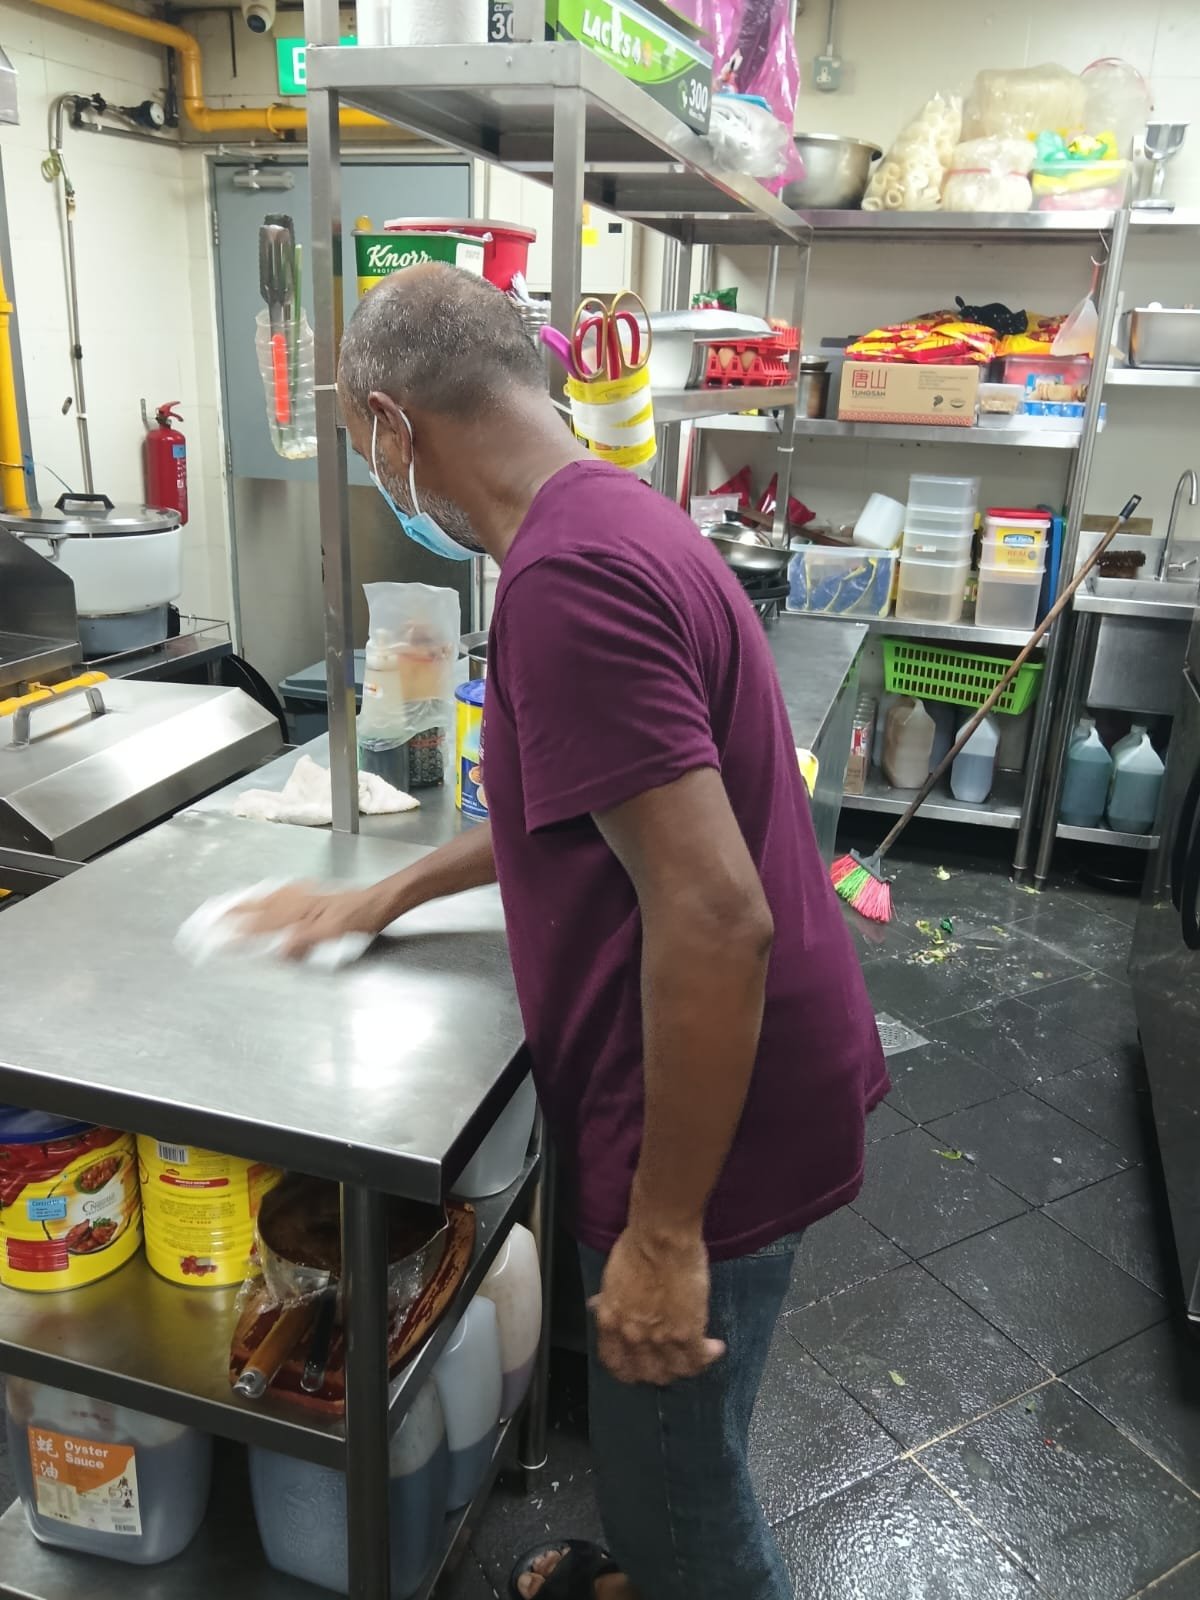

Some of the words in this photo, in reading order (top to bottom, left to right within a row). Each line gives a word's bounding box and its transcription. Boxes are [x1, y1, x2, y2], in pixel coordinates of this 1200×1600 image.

[689, 78, 709, 113] 300
[366, 244, 429, 268] Knorr
[851, 368, 888, 390] 唐山
[63, 1440, 109, 1458] Oyster
[64, 1452, 105, 1469] Sauce
